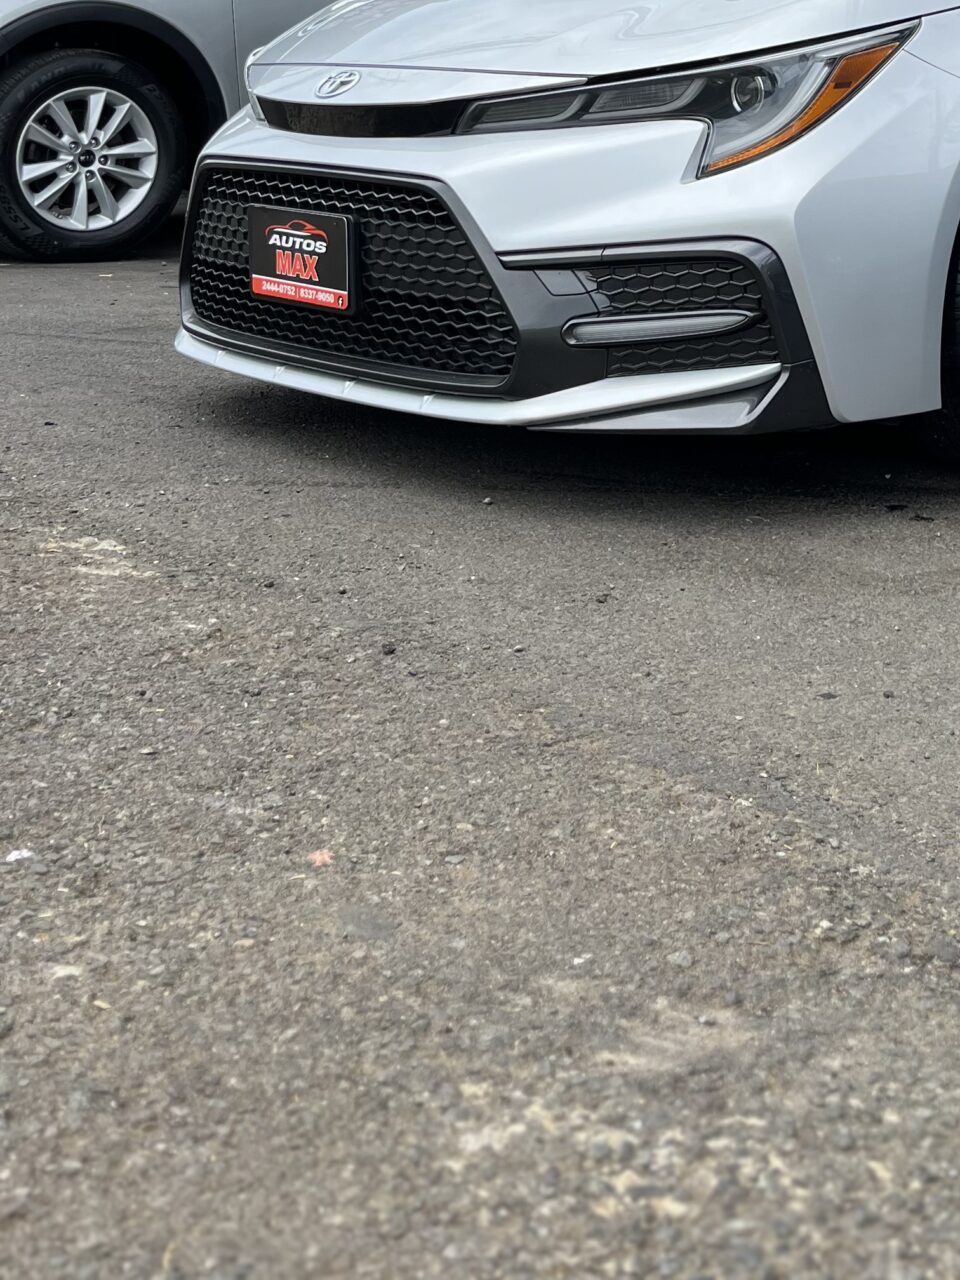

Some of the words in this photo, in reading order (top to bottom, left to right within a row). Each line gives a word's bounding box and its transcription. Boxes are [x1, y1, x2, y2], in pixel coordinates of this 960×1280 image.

[269, 234, 327, 253] AUTOS
[276, 250, 319, 281] MAX
[262, 281, 296, 296] 2444-0752
[300, 289, 335, 303] 8337-9050
